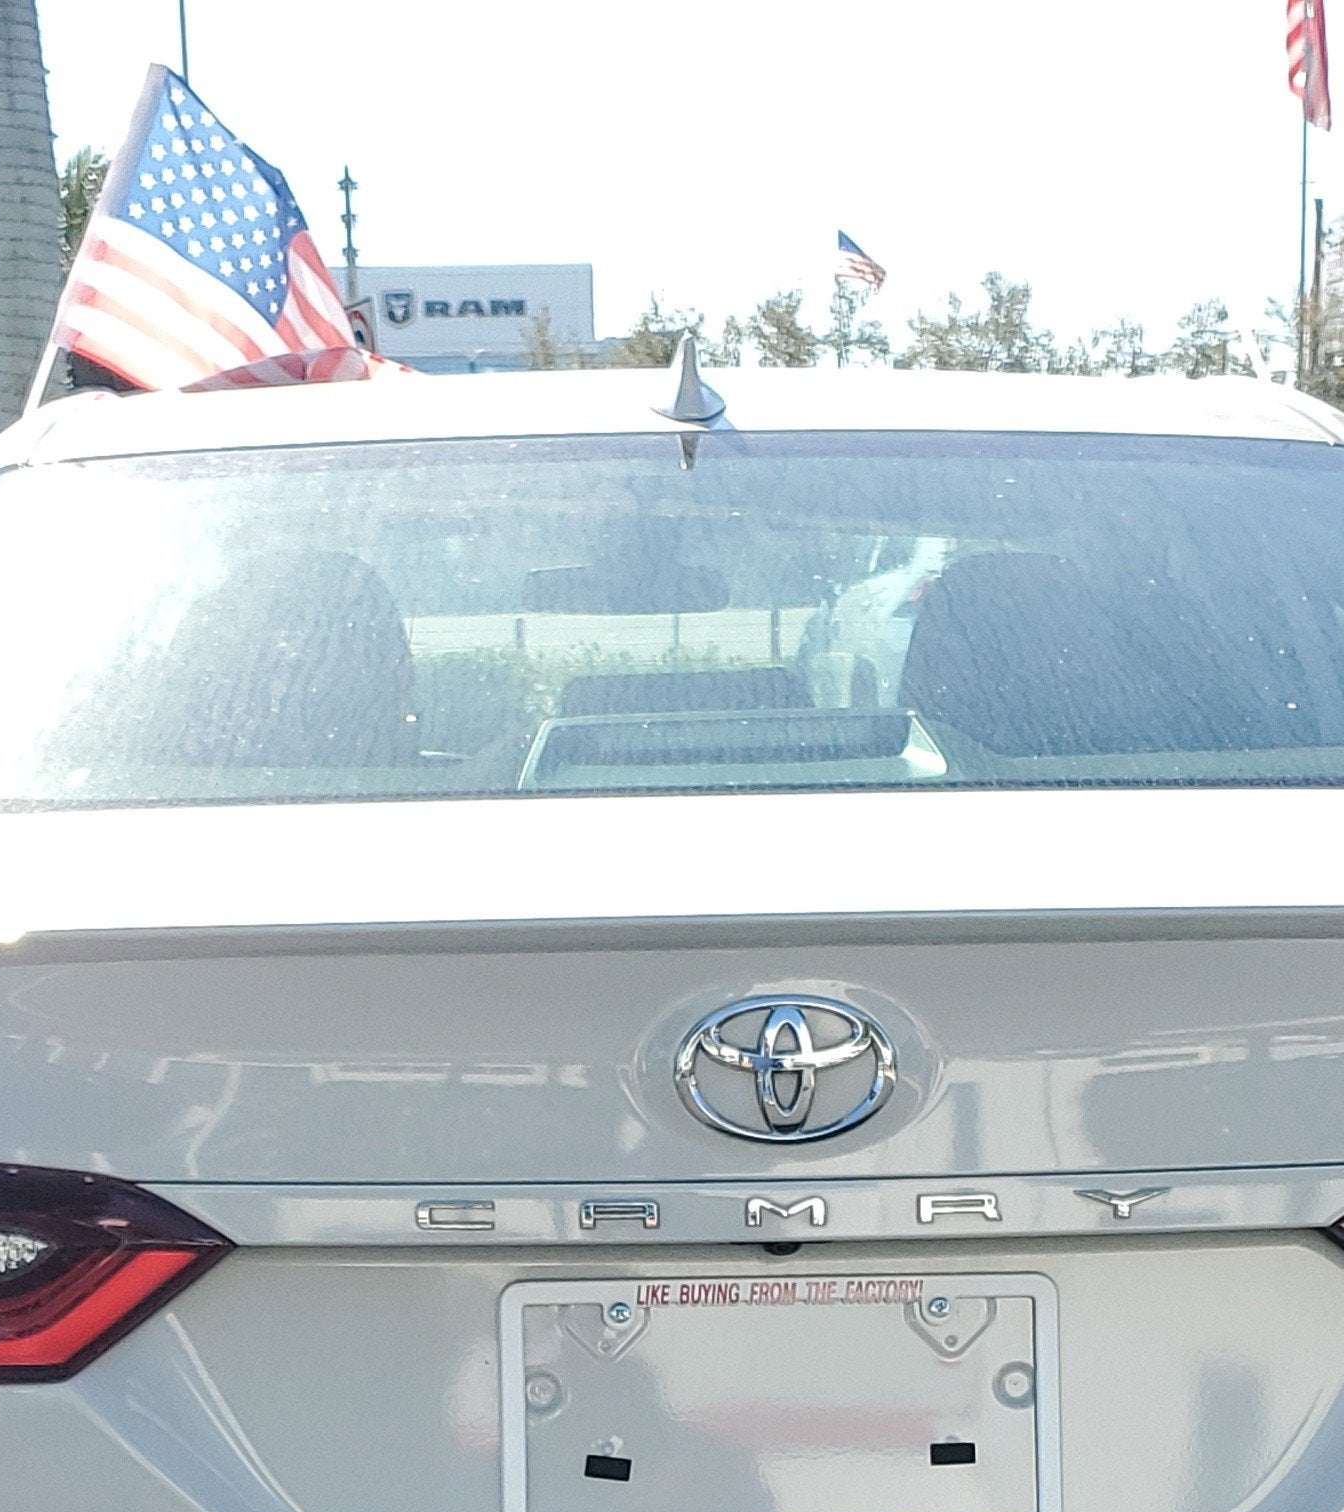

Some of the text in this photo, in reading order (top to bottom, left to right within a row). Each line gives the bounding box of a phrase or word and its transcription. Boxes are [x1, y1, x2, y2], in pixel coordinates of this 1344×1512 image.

[424, 299, 525, 317] RAM
[415, 1186, 1170, 1231] CAMRY
[635, 1279, 924, 1306] LIKE BUYING FROM THE FACTORY!
